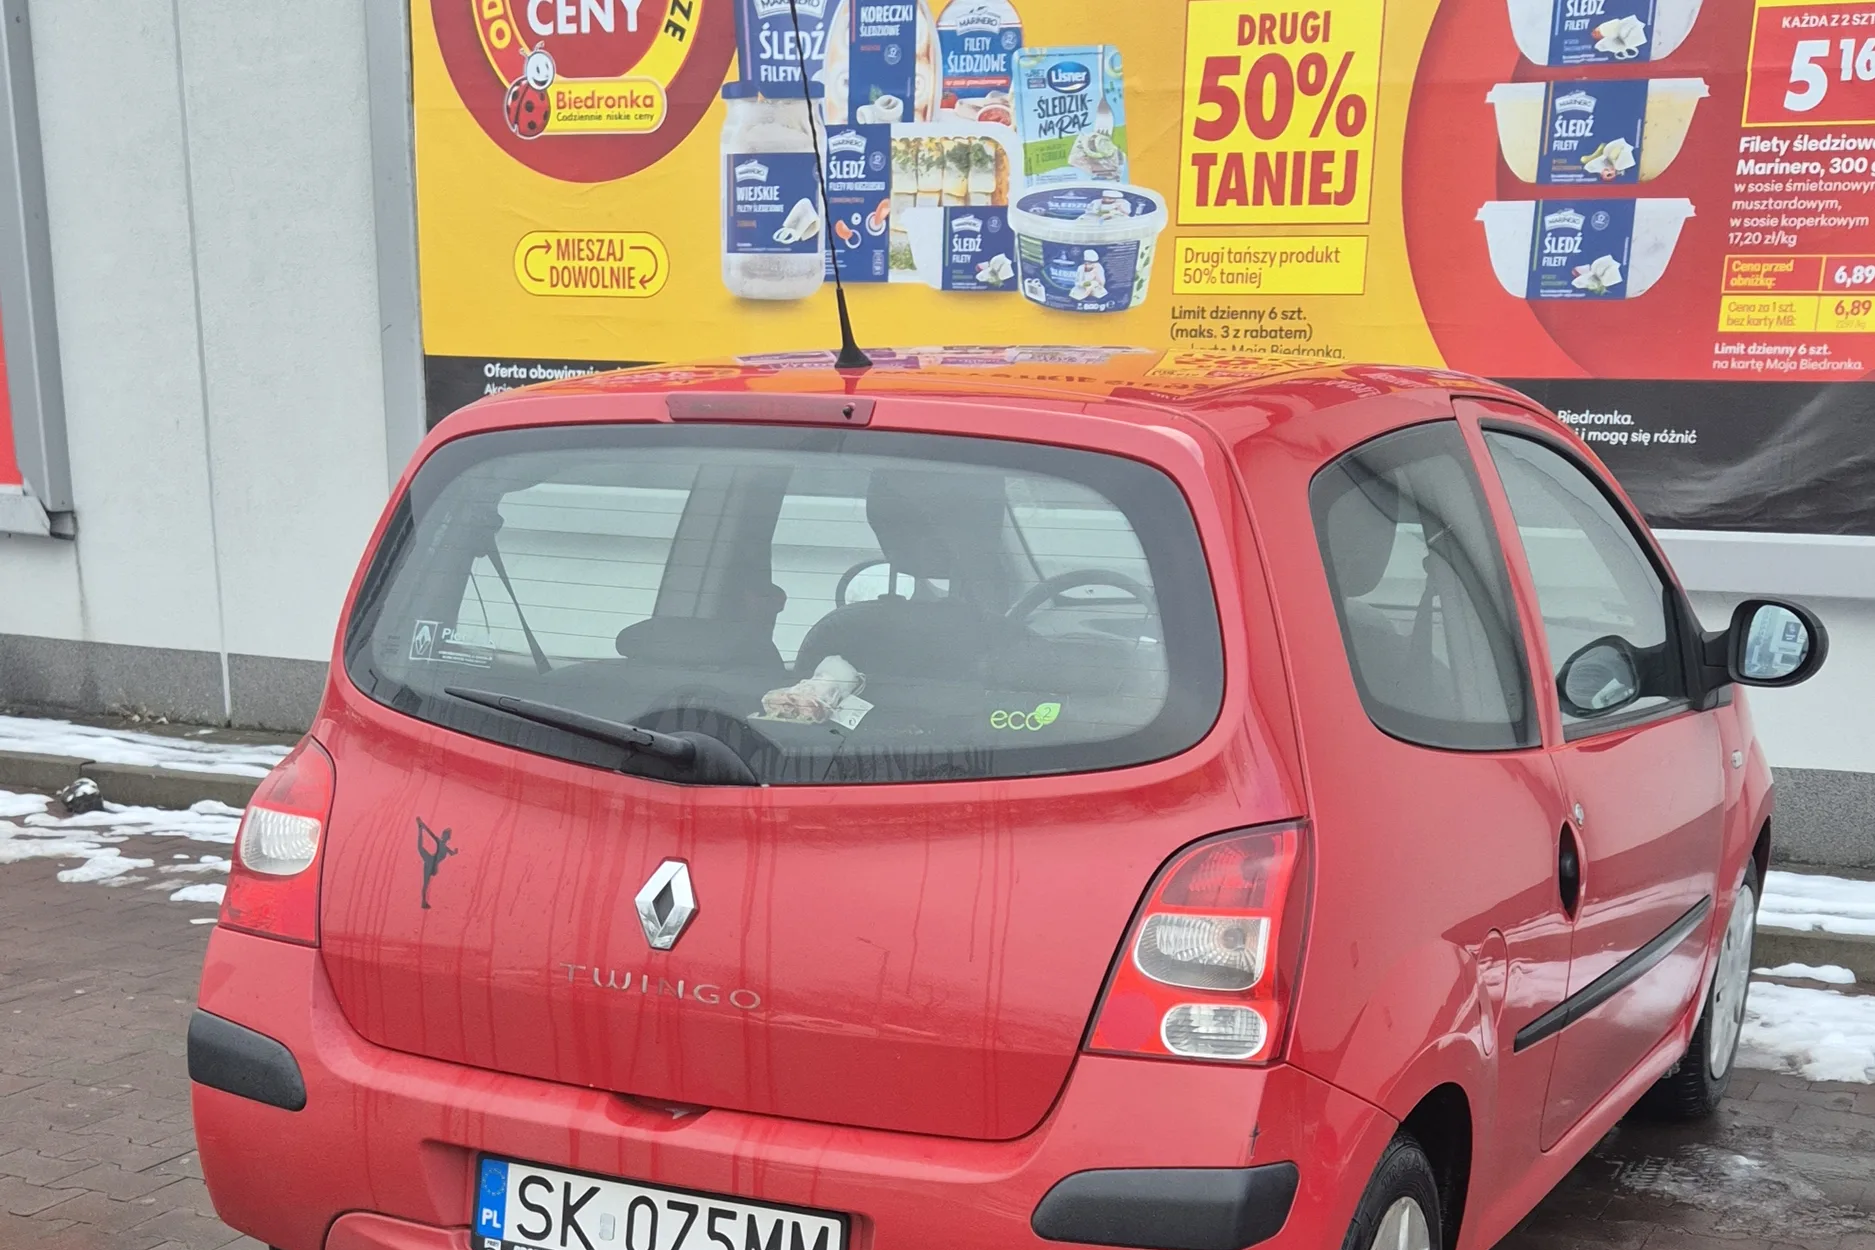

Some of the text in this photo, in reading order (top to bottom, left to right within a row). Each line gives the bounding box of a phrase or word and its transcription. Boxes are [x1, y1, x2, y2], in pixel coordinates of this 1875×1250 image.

[527, 0, 644, 36] CENY
[860, 5, 913, 23] KORECZKI
[1781, 13, 1829, 28] KAŻDA
[1830, 14, 1840, 27] Z
[1841, 14, 1850, 26] 2
[1237, 11, 1331, 46] DRUGI
[1564, 19, 1590, 31] FILETY
[759, 22, 825, 61] ŚLEDŹ
[964, 37, 991, 52] FILETY
[947, 51, 1007, 73] ŚLEDZIOWE
[1051, 67, 1088, 83] Lisner
[556, 89, 655, 110] Biedronka
[1193, 51, 1367, 142] 50%
[556, 112, 655, 122] Codziennie niskie ceny
[1038, 112, 1092, 139] NA RAZ
[1554, 115, 1594, 137] ŚLEDŹ
[1553, 140, 1579, 151] FILETY
[1739, 135, 1791, 157] Filety
[829, 156, 866, 179] ŚLEDŹ
[1736, 158, 1825, 178] Marinero,
[1829, 157, 1868, 174] 300
[1191, 150, 1359, 207] TANIEJ
[1734, 182, 1746, 193] w
[1747, 180, 1783, 193] sosie
[736, 186, 780, 201] WIEJSKIE
[1731, 196, 1842, 213] musztardowym,
[1729, 214, 1869, 230] w sosie koperkowym
[952, 234, 982, 253] ŚLEDŹ
[1543, 232, 1583, 254] ŚLEDŹ
[1728, 230, 1797, 248] 17,20 zł/kg
[556, 239, 625, 262] MIESZAJ
[952, 254, 971, 264] FILETY
[1184, 246, 1341, 268] Drugi tańszy produkt
[1542, 256, 1567, 267] FILETY
[550, 266, 636, 290] DOWOLNIE
[1183, 268, 1262, 289] 50% taniej
[1731, 259, 1875, 288] Cena przed 6,89
[1171, 306, 1307, 324] Limit dzienny 6 szt.
[1728, 302, 1756, 313] Cena
[1757, 303, 1770, 313] za
[1778, 302, 1796, 313] szt.
[1834, 299, 1873, 320] 6,89
[1726, 316, 1745, 326] bez
[1746, 315, 1774, 329] karty
[1170, 323, 1313, 342] (maks. 3 z rabatem)
[1714, 343, 1832, 357] Limit dzienny 6 szt.
[484, 363, 527, 379] Oferta
[1712, 358, 1864, 373] na kartę Moja Biedronka.
[1557, 410, 1635, 426] Biedronka.
[1588, 430, 1629, 446] mogą
[1631, 429, 1651, 446] się
[1653, 428, 1698, 444] różnić
[560, 963, 761, 1010] TWINGO
[481, 1207, 502, 1229] PL
